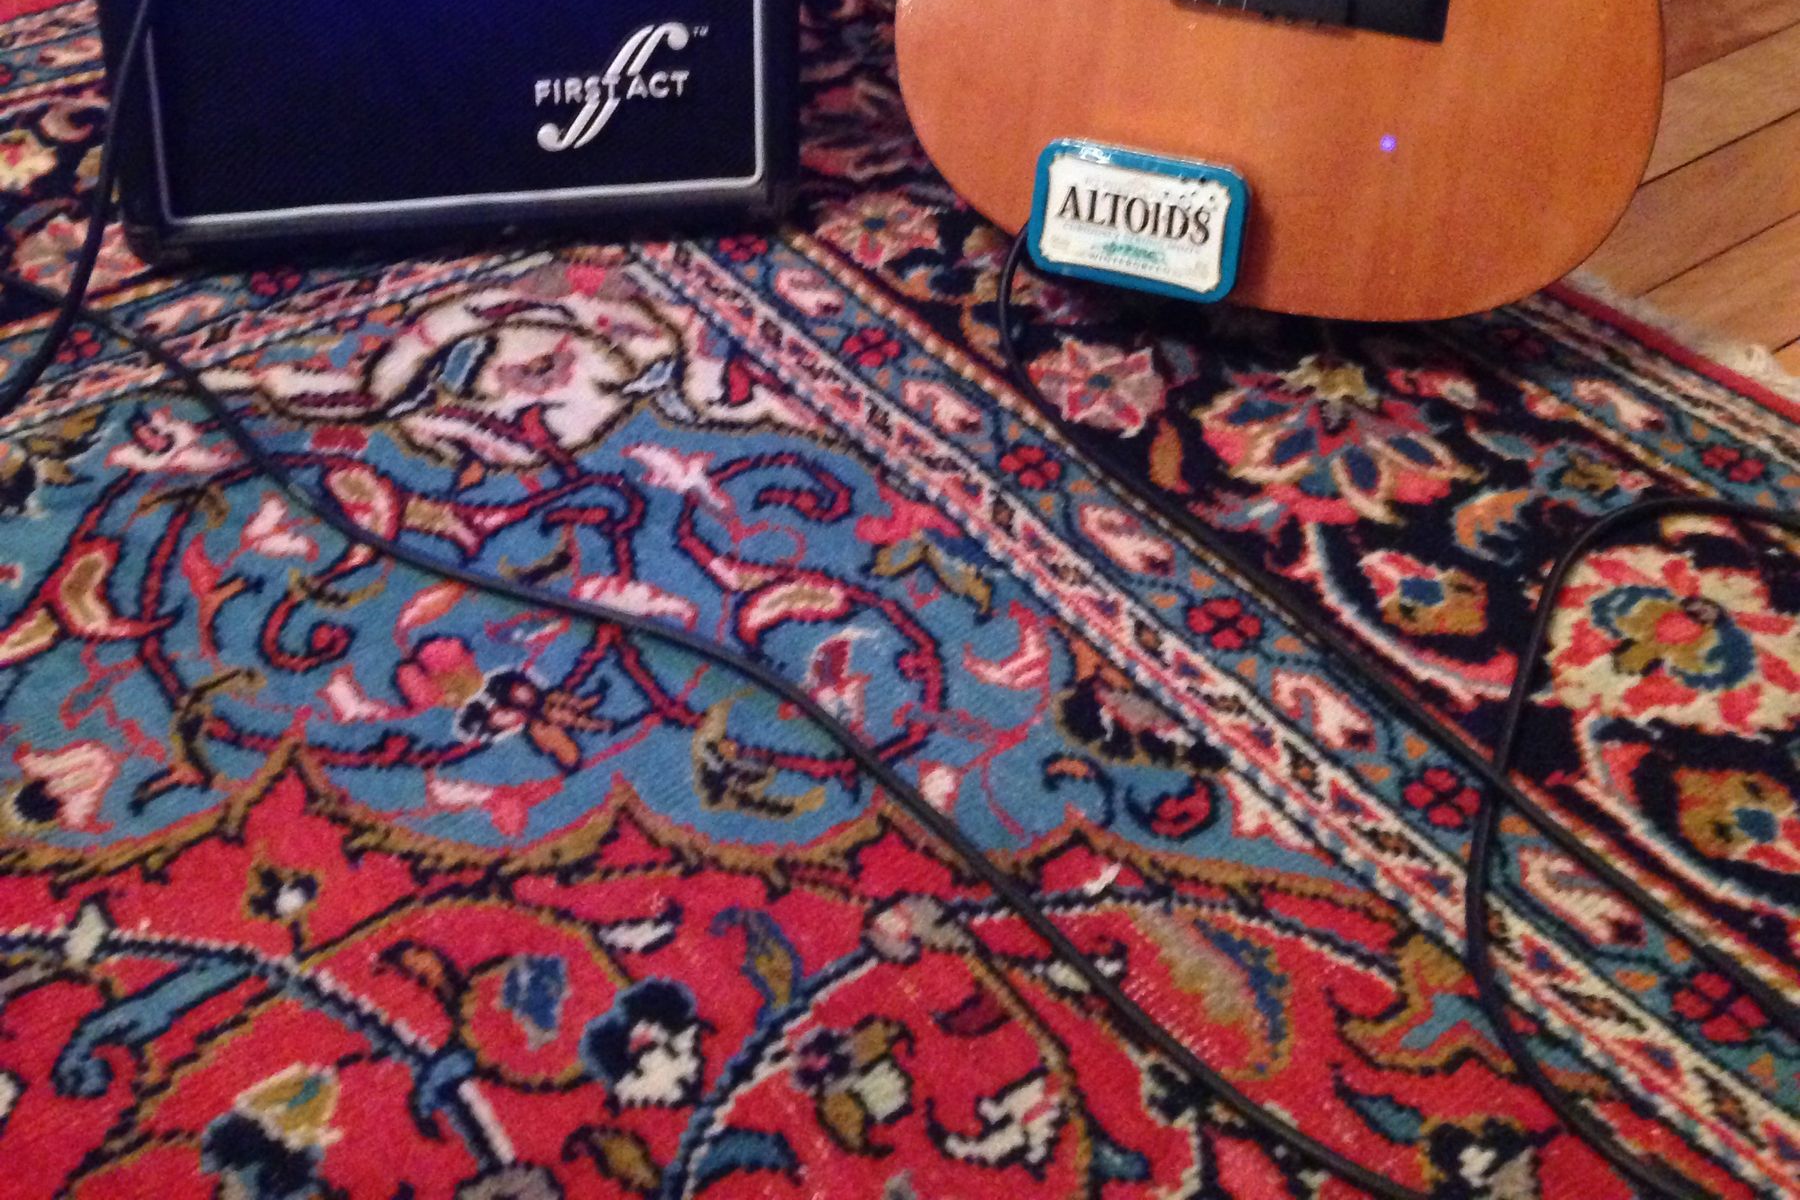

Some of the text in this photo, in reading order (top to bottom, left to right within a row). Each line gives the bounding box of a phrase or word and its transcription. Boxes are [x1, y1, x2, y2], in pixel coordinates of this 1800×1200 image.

[534, 69, 690, 106] FIRST ACT
[1058, 185, 1211, 246] ALTOIDS
